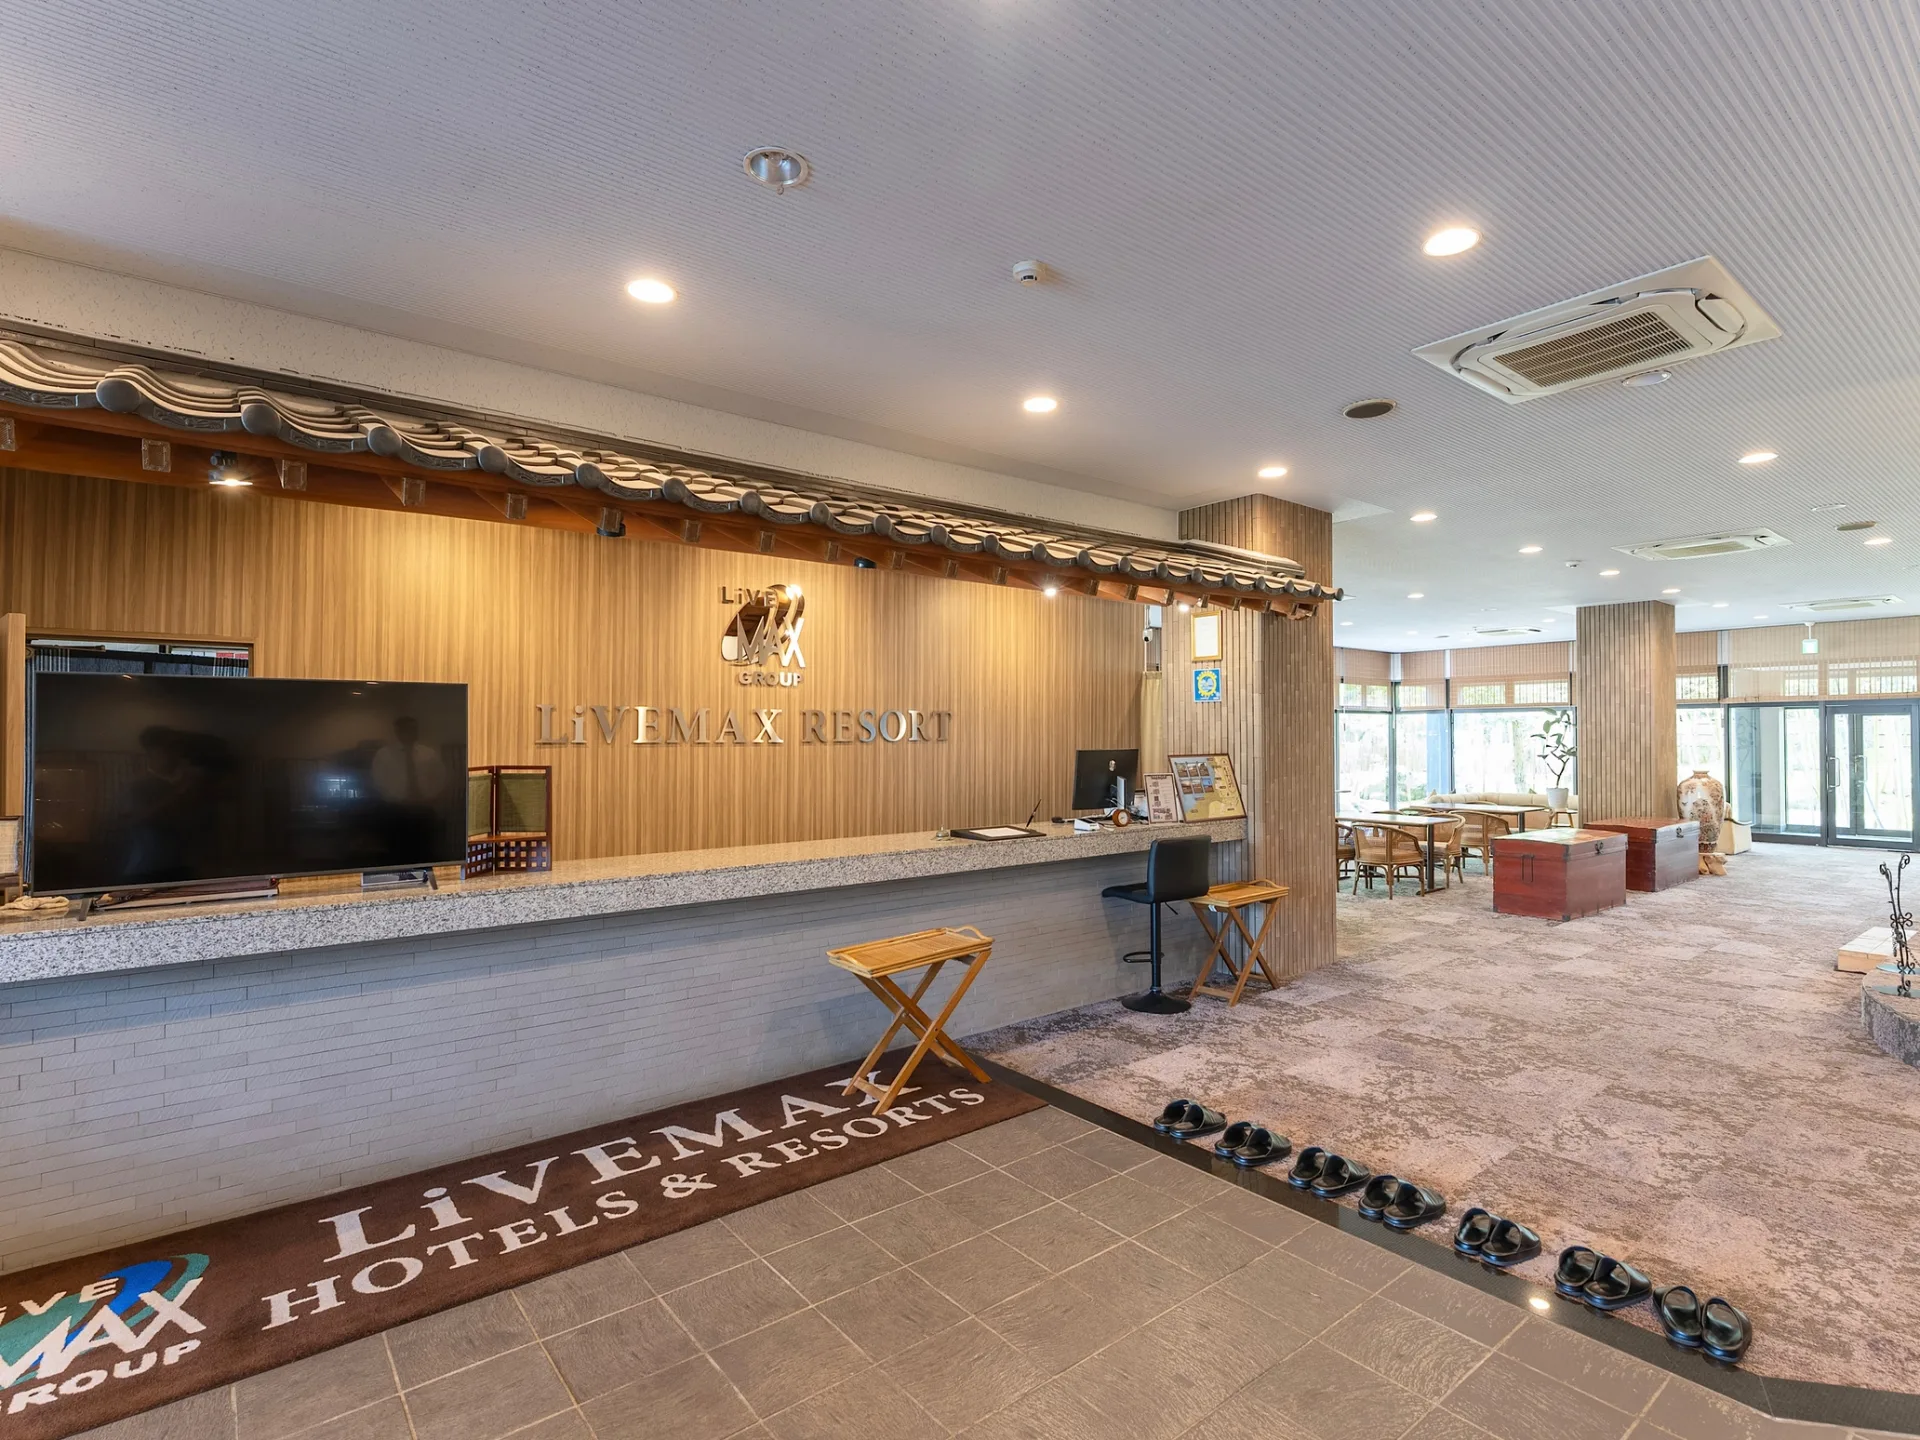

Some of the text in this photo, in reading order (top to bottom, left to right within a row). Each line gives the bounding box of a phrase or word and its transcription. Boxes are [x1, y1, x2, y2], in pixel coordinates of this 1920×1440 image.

[721, 586, 777, 608] LiVE
[736, 613, 805, 668] MAX
[738, 671, 804, 687] GROUP
[535, 703, 952, 745] LiVEMAX RESORT
[319, 1069, 922, 1262] LiVEMAX
[261, 1087, 986, 1331] HOTELS & RESORTS
[0, 1338, 202, 1415] ROUP
